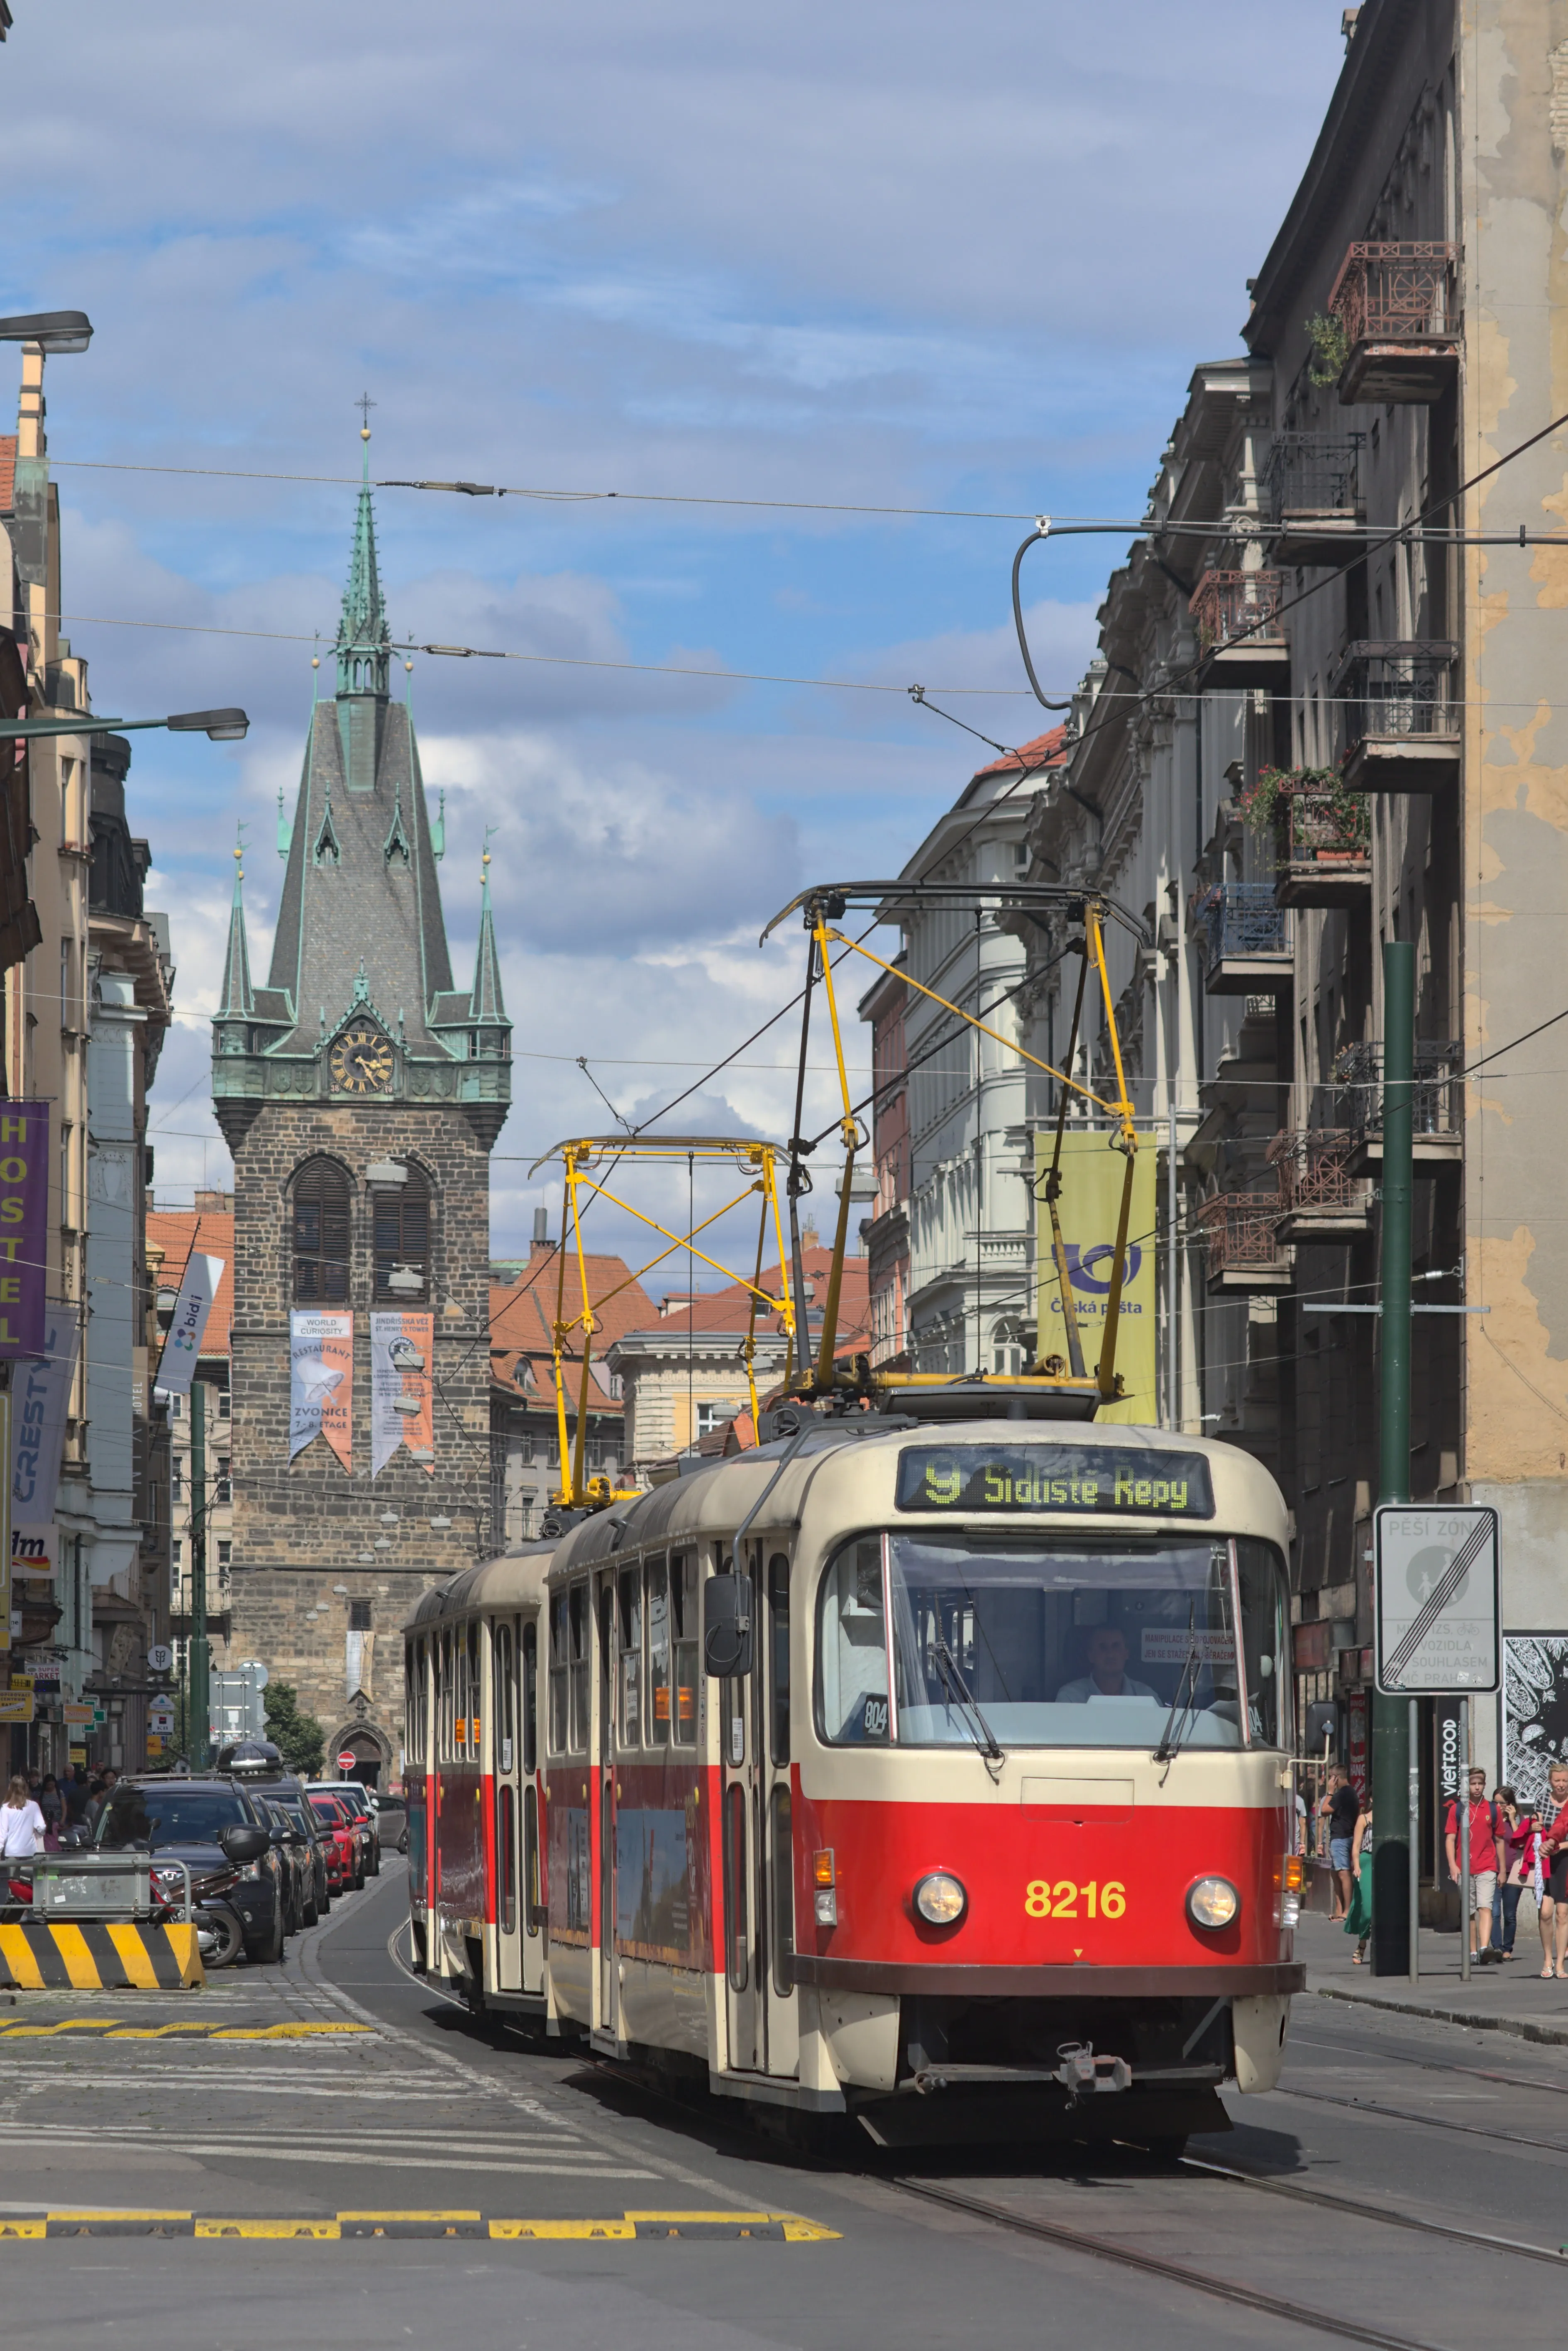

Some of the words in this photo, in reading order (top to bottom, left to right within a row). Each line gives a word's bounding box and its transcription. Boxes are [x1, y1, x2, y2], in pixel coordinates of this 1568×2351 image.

[0, 1117, 27, 1343] HOSTEL
[1051, 1298, 1097, 1313] Čská
[1101, 1301, 1142, 1316] pšta
[375, 1316, 414, 1325] JINDŘIŠSKÁ
[293, 1345, 351, 1360] RESTAURANT
[133, 1382, 142, 1415] HOTEL
[295, 1408, 347, 1417] ZVONICE
[926, 1455, 960, 1504] 9
[1389, 1517, 1430, 1536] PĚŠÍ
[1145, 1634, 1183, 1644] MANIPULACE
[1420, 1641, 1472, 1651] VOZIDLA
[1145, 1649, 1155, 1658] JEN
[1158, 1650, 1165, 1658] SE
[1412, 1657, 1487, 1667] SOUHLASEM
[1425, 1673, 1462, 1684] PRAH
[865, 1701, 887, 1730] 804
[1248, 1706, 1263, 1732] 04
[1025, 1880, 1126, 1919] 8216
